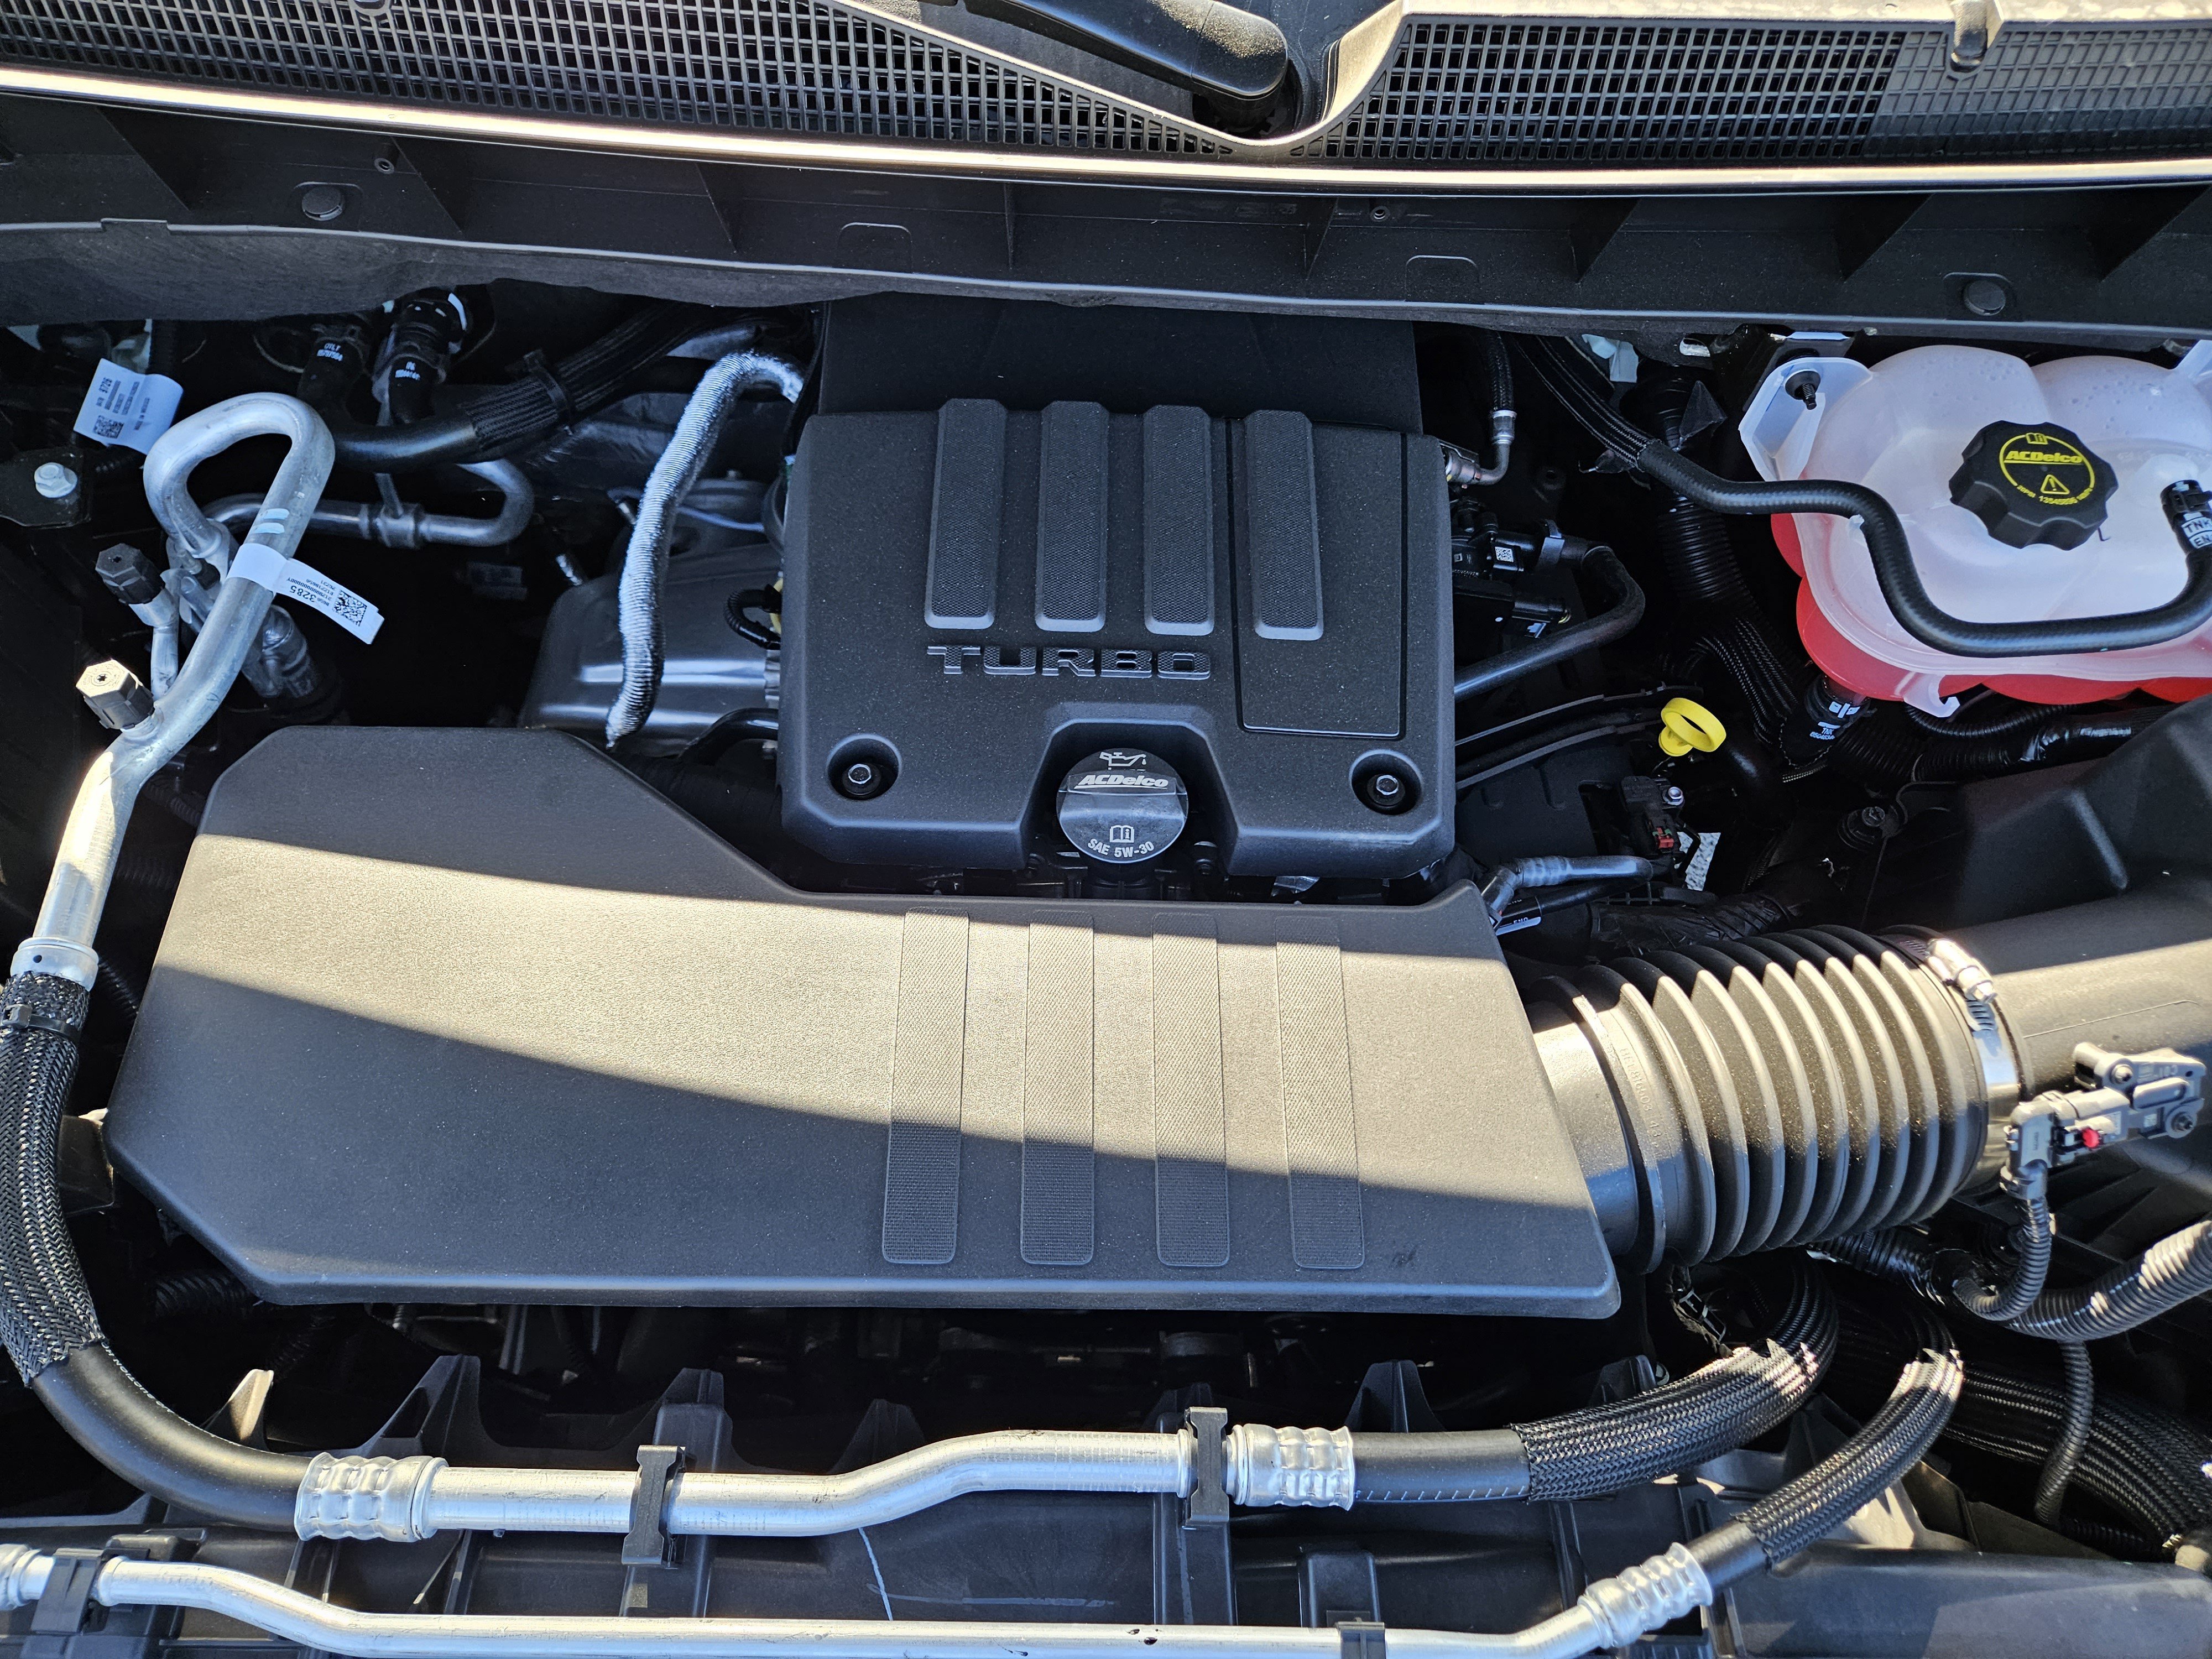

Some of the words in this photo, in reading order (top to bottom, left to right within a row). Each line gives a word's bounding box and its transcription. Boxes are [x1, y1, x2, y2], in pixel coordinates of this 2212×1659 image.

[2006, 451, 2083, 463] ACDelco
[2194, 534, 2212, 546] EN
[289, 585, 317, 603] 3285
[927, 646, 1211, 680] TURBO
[1078, 775, 1168, 787] ACDelco
[1087, 838, 1110, 855] SAE
[1114, 841, 1155, 858] 5W-30
